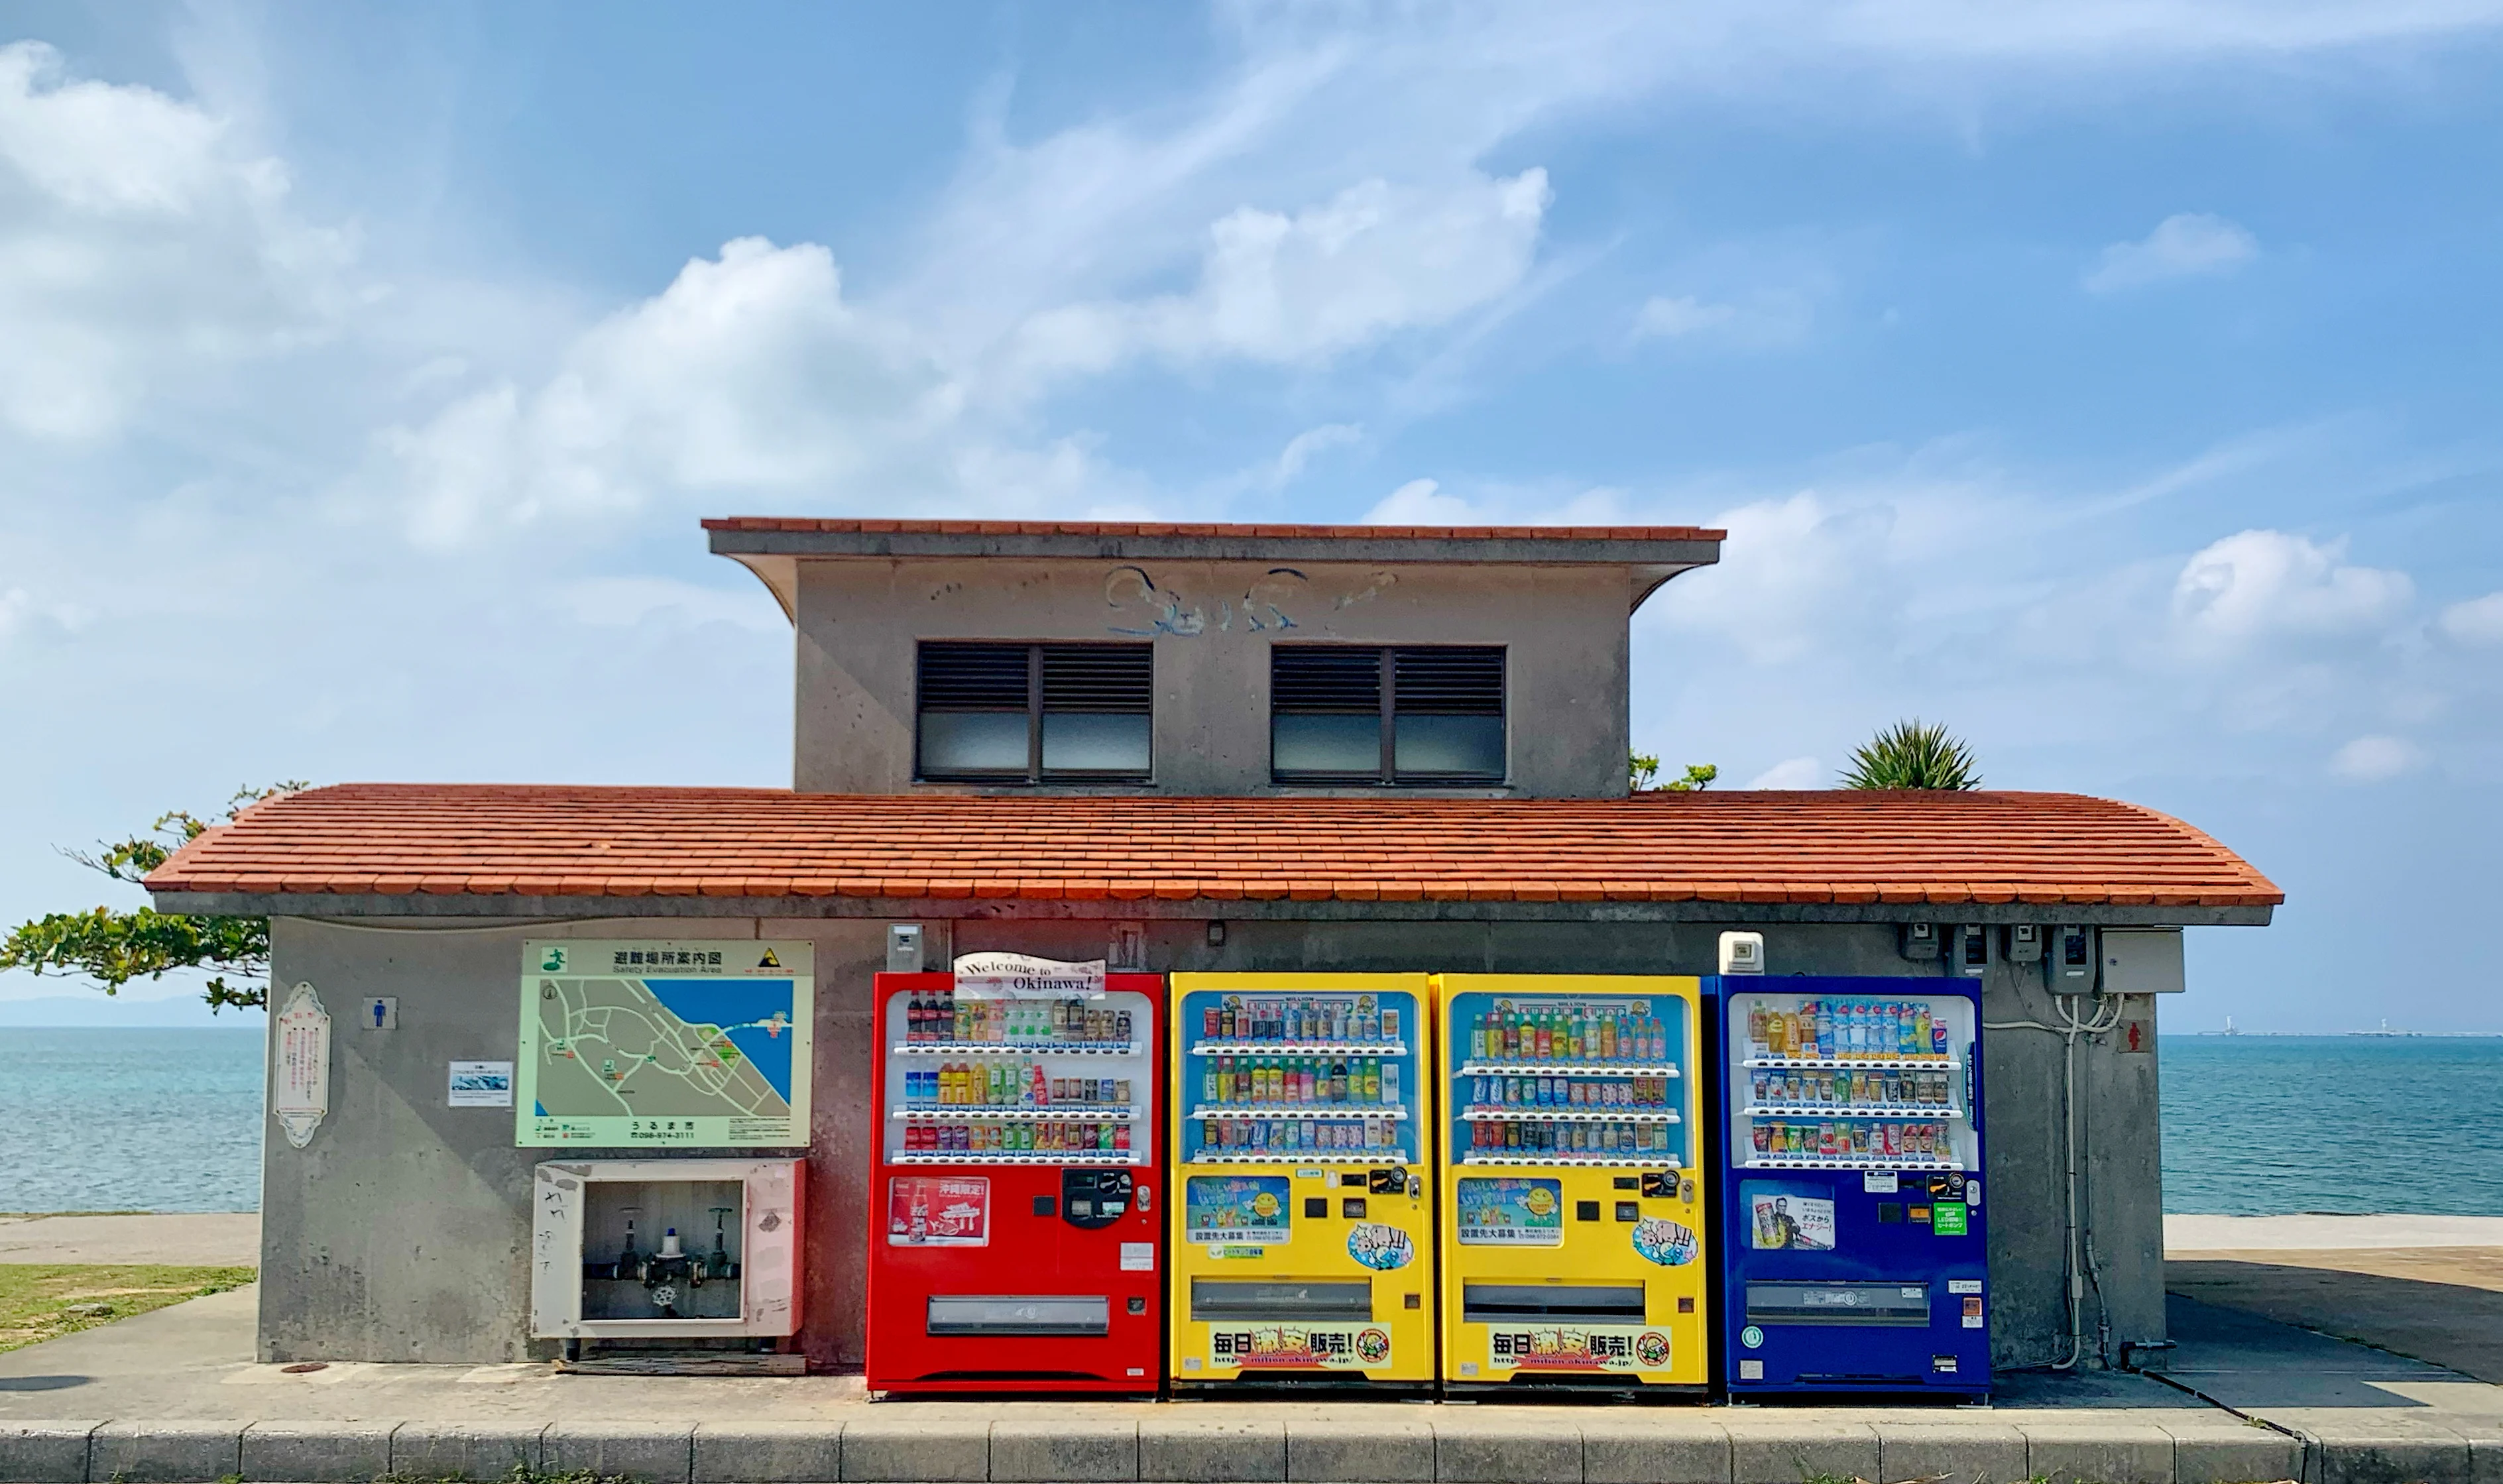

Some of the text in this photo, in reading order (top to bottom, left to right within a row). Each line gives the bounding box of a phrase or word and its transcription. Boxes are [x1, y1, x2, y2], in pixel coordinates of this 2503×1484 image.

[614, 951, 722, 965] 避難場所案内図
[964, 961, 1035, 976] Welcome
[1013, 976, 1092, 991] Okinawa!
